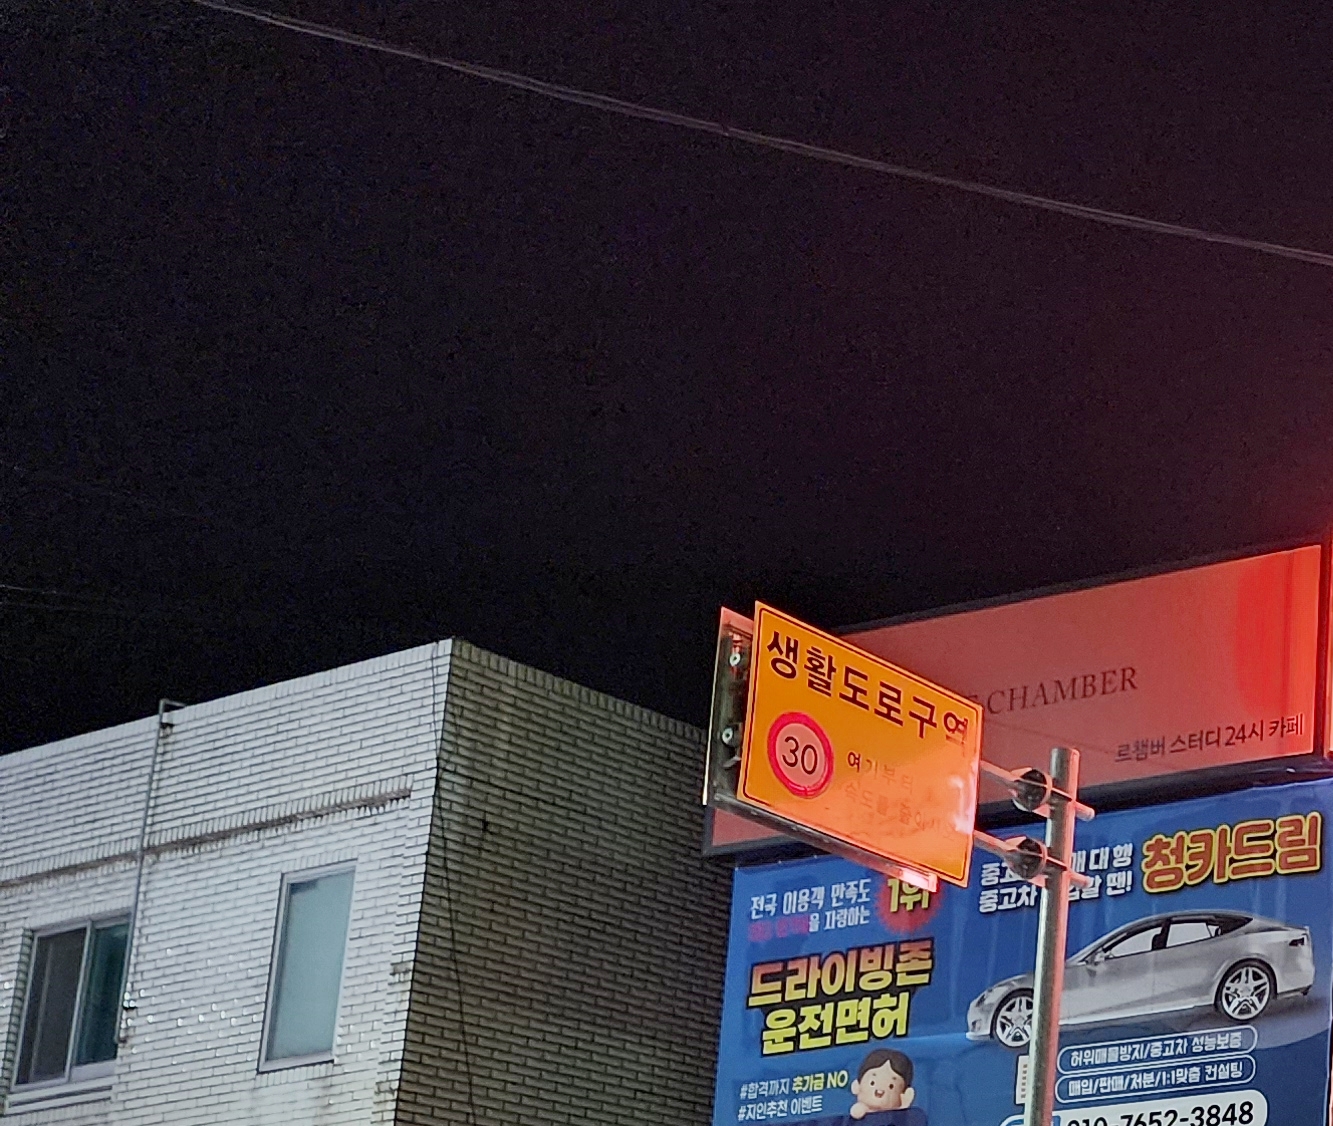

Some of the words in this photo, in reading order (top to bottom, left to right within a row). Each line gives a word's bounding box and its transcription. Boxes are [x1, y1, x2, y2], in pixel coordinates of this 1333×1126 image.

[767, 630, 969, 746] 생활도로구역
[986, 666, 1138, 715] CHAMBER
[781, 735, 819, 776] 30
[1115, 735, 1165, 762] 르챔버
[1268, 714, 1303, 738] 카페
[1141, 811, 1323, 894] 청카드림
[751, 893, 777, 919] 전국
[782, 886, 825, 915] 이용객
[831, 879, 871, 907] 만족도
[888, 879, 930, 914] 1위
[979, 885, 1037, 913] 중고차
[824, 905, 871, 930] 자랑하는
[748, 940, 934, 1007] 드라이빙존
[761, 992, 909, 1055] 운전면허
[1192, 1032, 1242, 1053] 성능보증
[739, 1078, 790, 1101] #합격까지
[792, 1072, 825, 1094] 추가금
[827, 1070, 849, 1089] NO
[1205, 1062, 1243, 1081] 컨설팅
[738, 1099, 788, 1122] #지인추천
[790, 1095, 823, 1115] 이벤트
